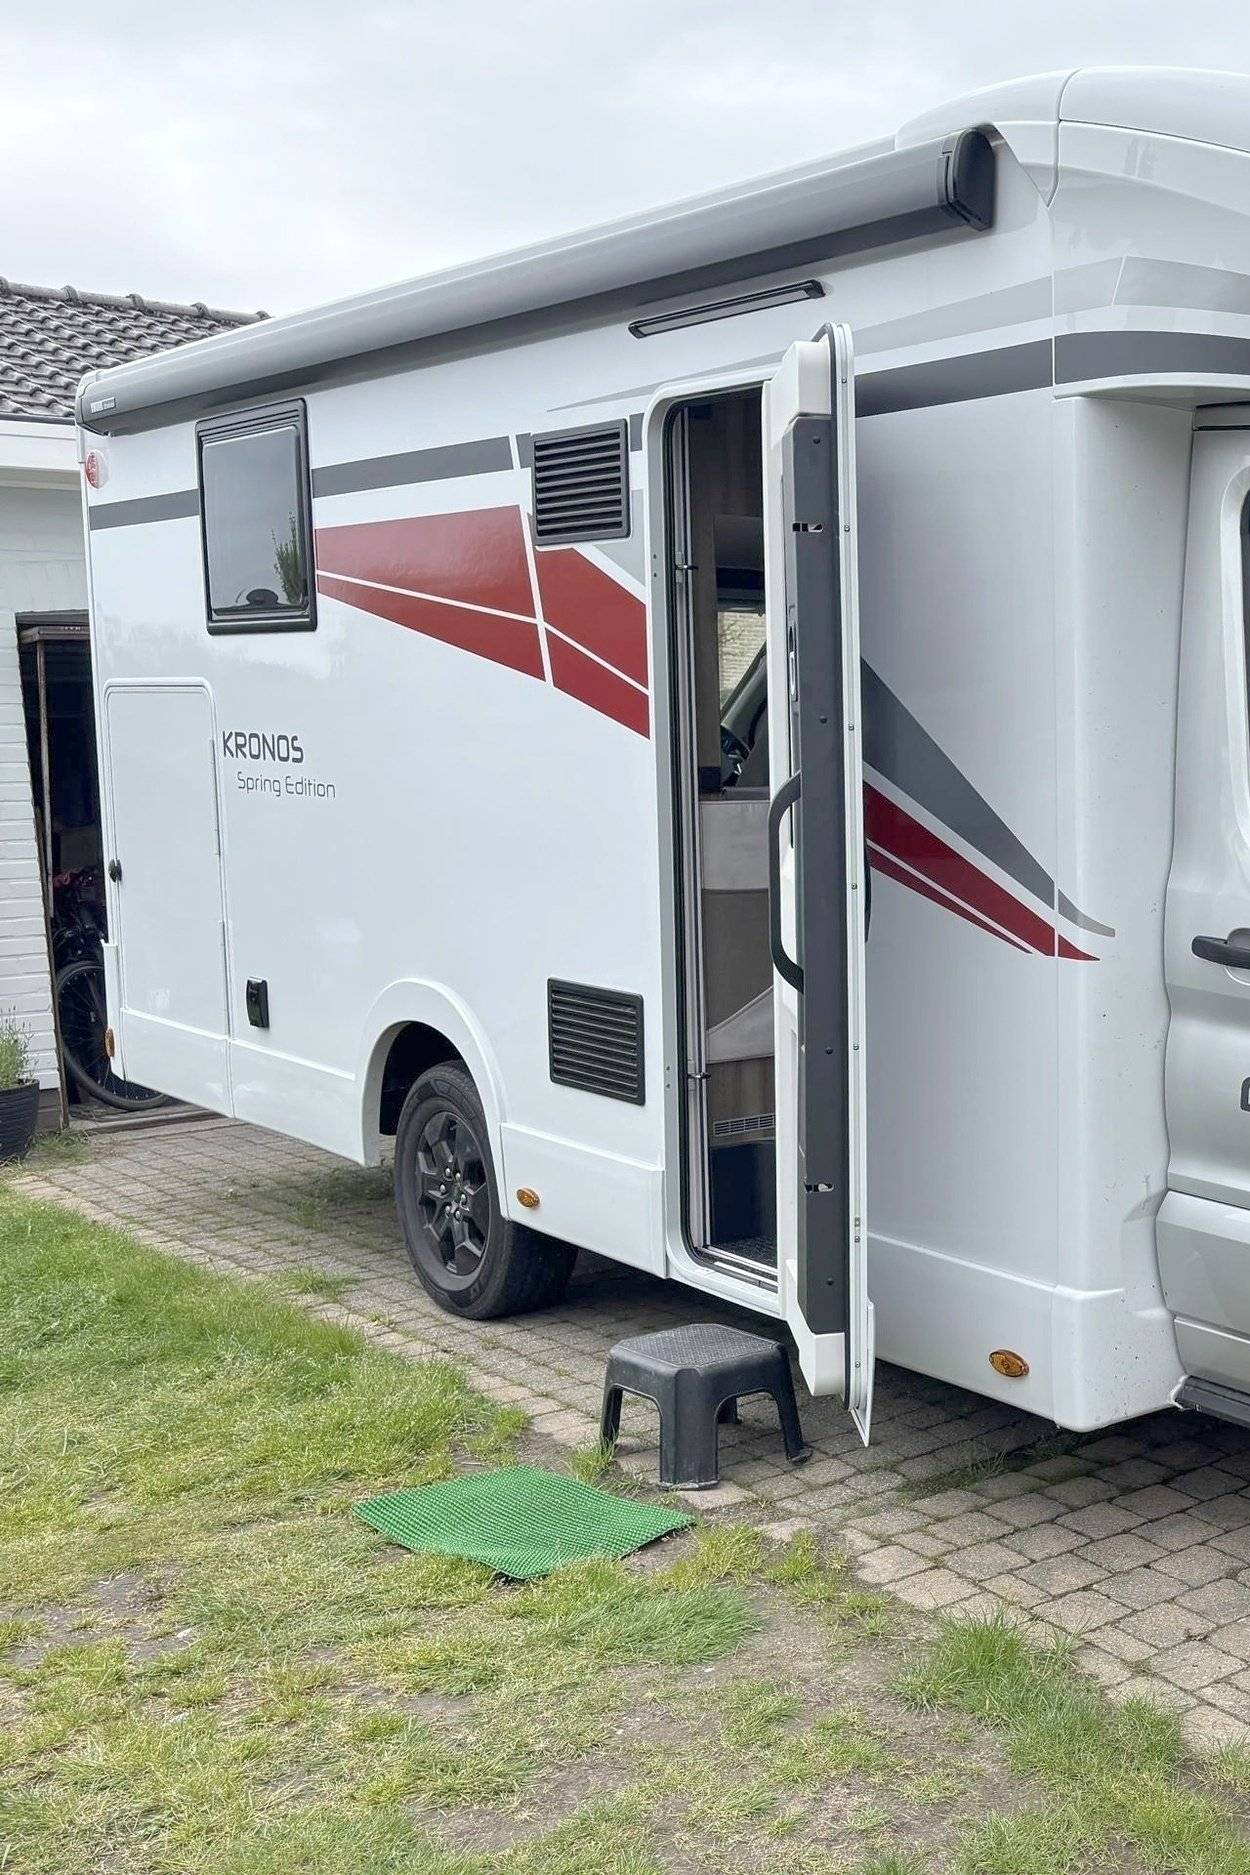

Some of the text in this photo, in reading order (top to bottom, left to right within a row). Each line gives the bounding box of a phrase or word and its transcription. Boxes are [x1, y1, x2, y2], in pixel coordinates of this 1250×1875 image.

[222, 730, 304, 763] KRONOS
[237, 771, 336, 798] Spring Edition
